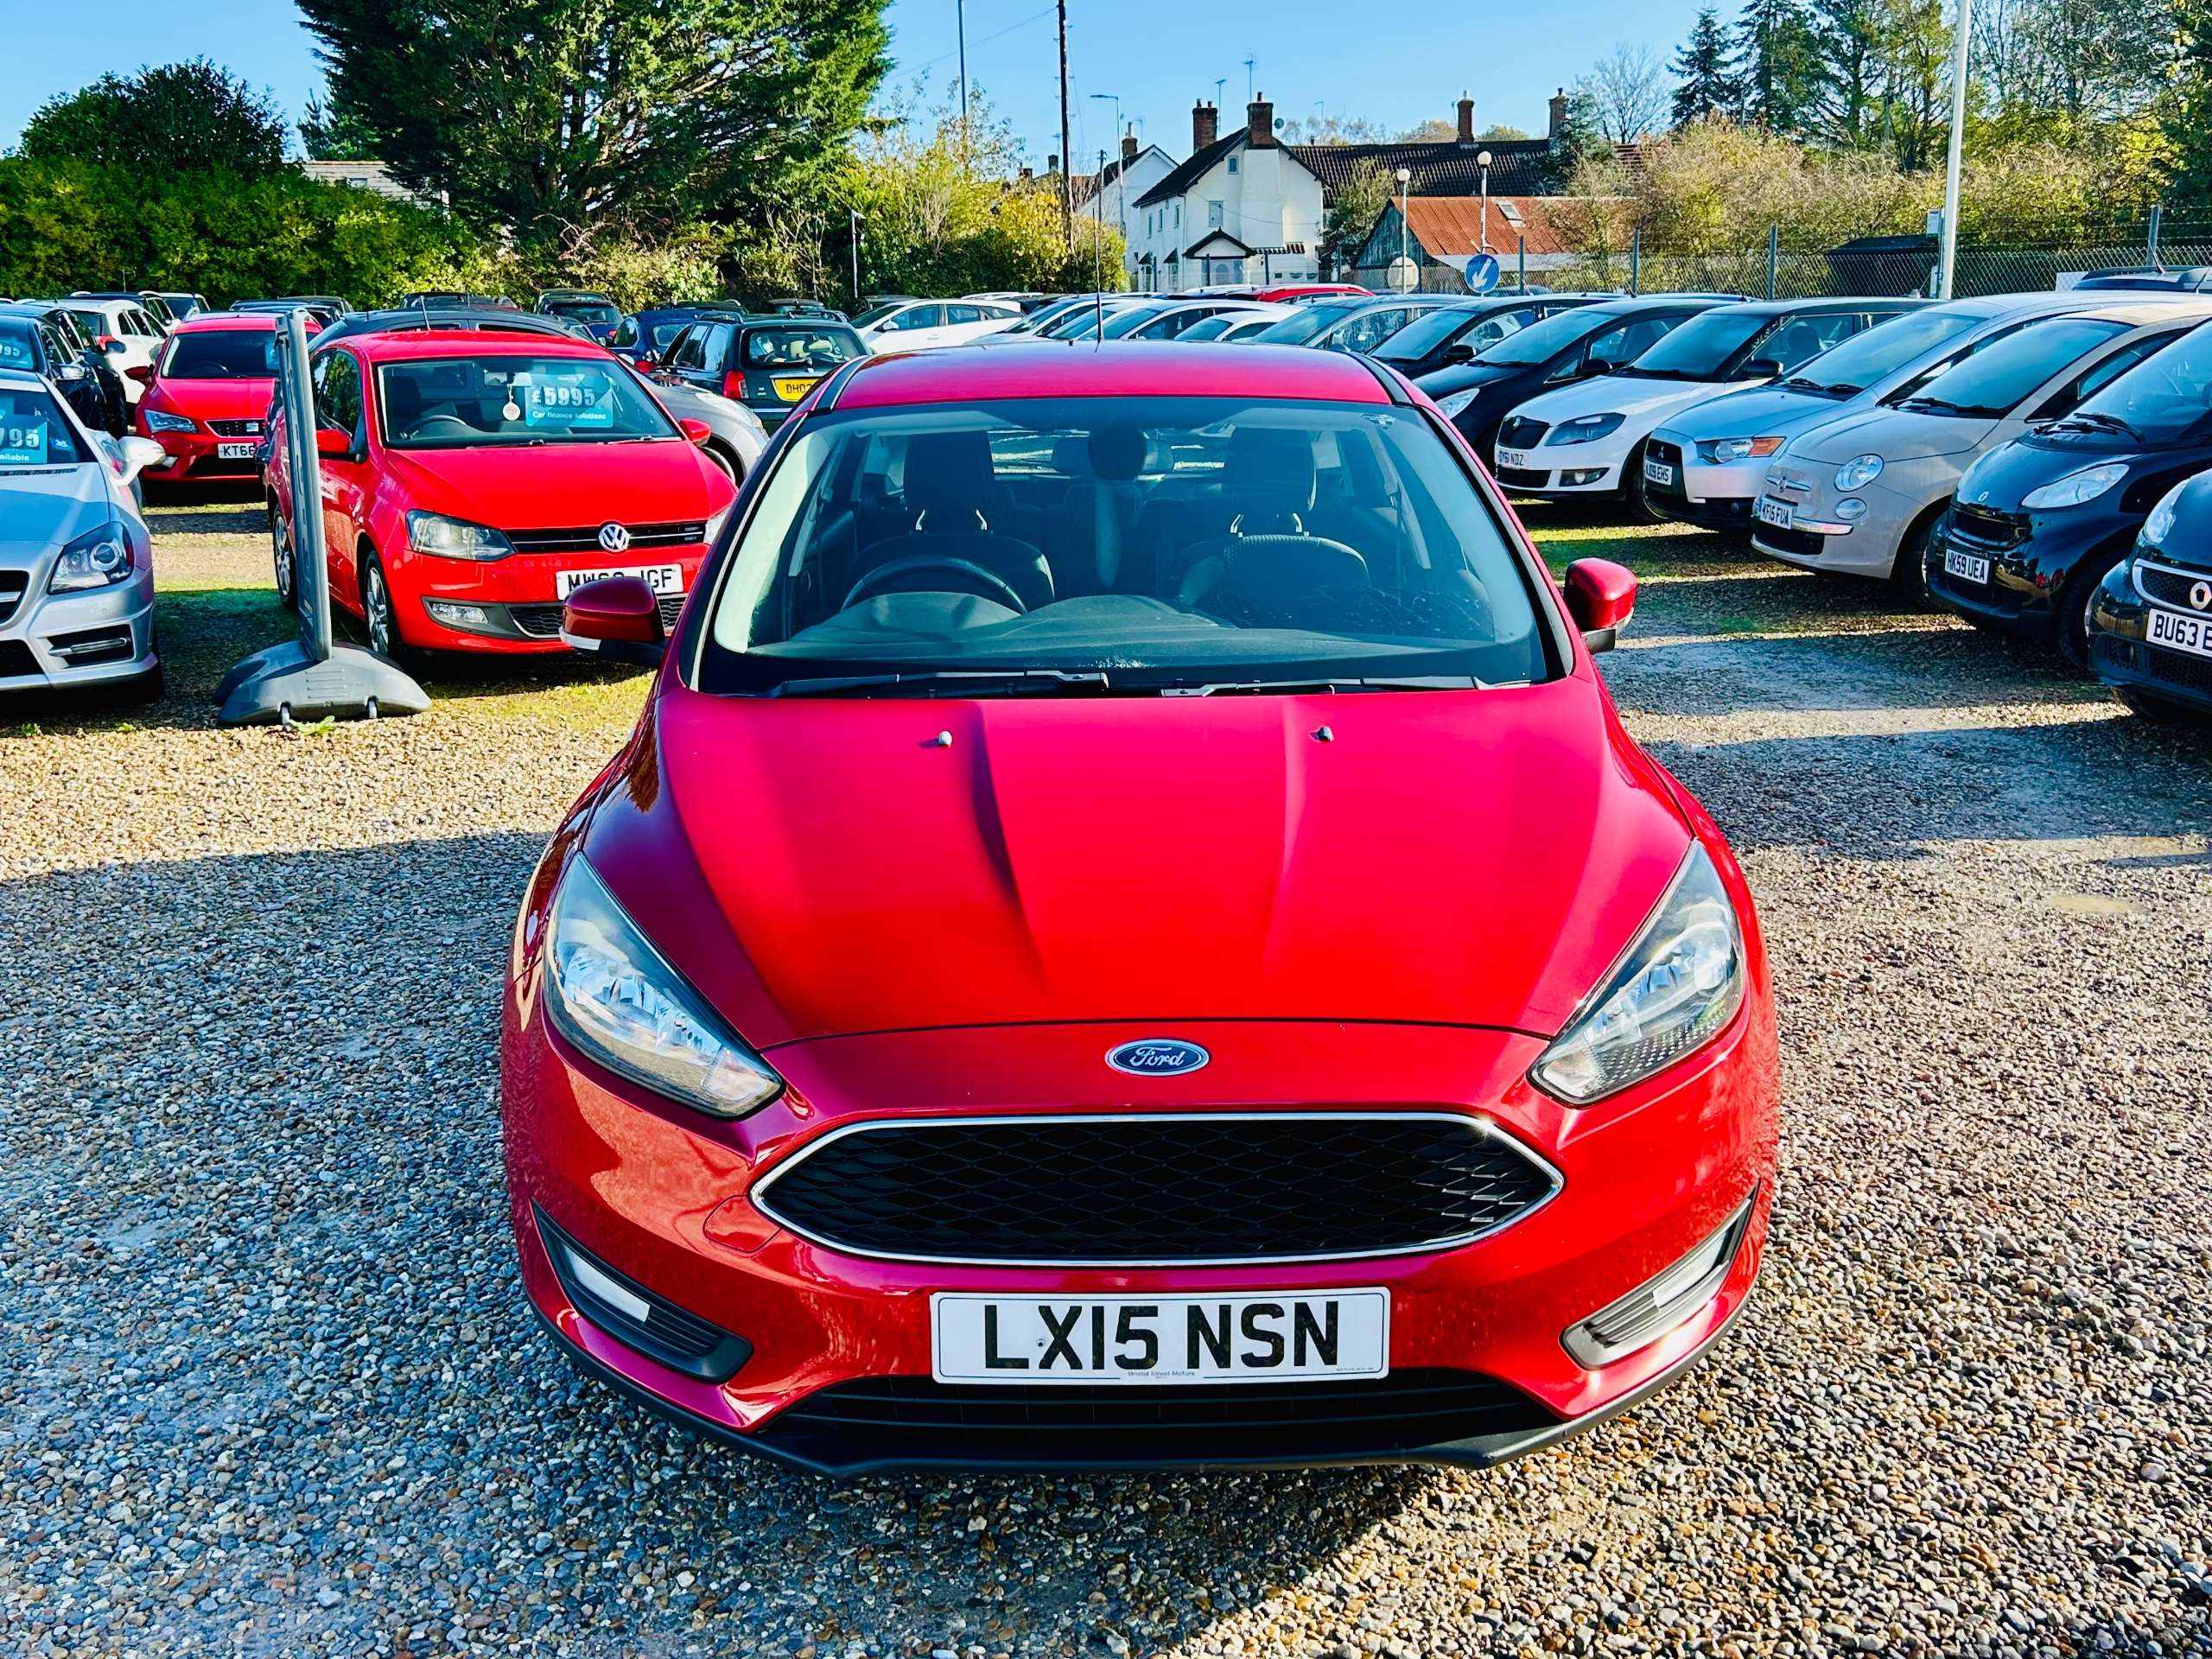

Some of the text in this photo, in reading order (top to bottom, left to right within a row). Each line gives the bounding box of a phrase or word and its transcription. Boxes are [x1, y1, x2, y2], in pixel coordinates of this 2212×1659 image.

[531, 386, 595, 406] £5995
[532, 410, 607, 420] Car finance solutions
[1657, 467, 1669, 481] EHS
[1948, 551, 1985, 582] HK59 UEA
[2153, 613, 2199, 647] BU63
[1128, 1046, 1186, 1067] Ford
[984, 1300, 1339, 1370] LX15 NSN
